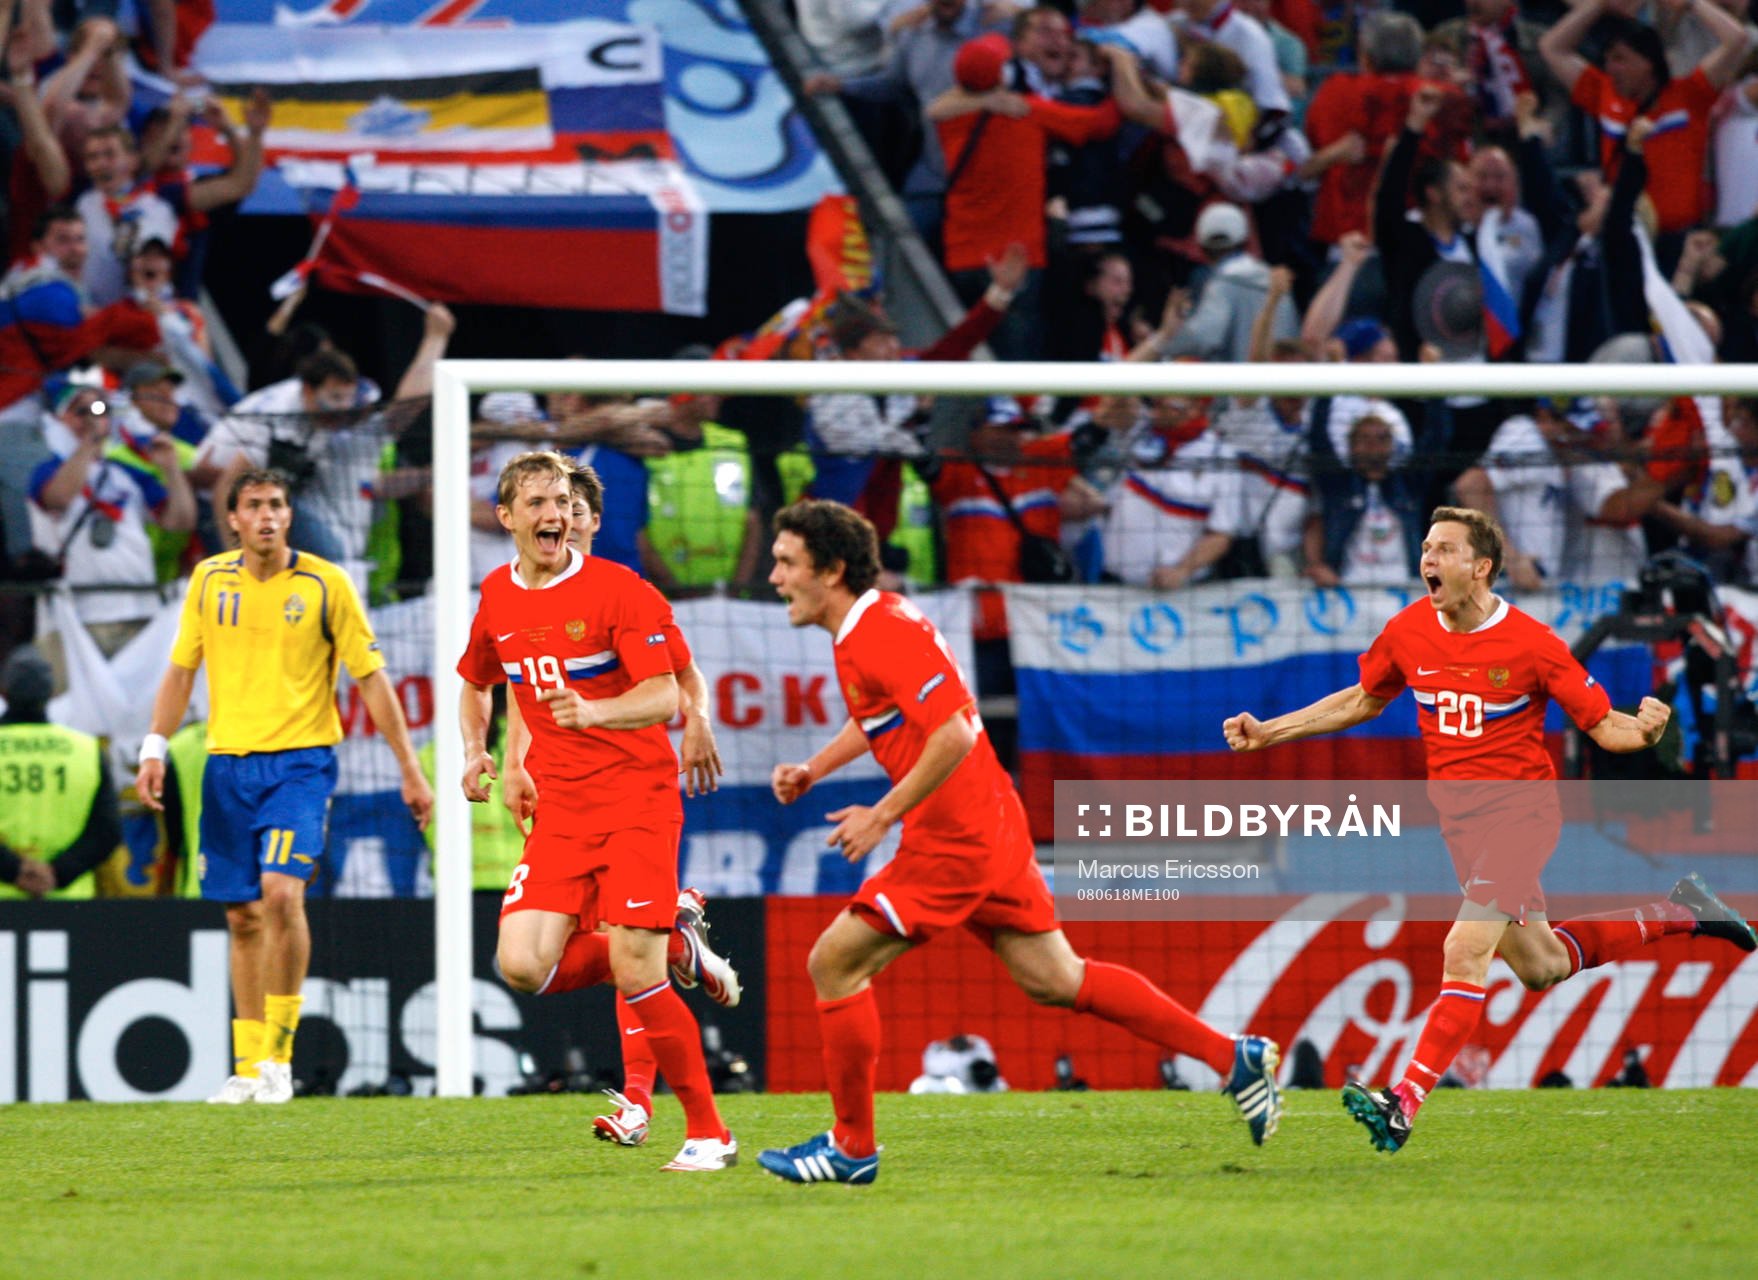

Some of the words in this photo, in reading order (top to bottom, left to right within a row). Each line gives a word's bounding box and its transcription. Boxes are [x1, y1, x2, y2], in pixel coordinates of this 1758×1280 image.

[217, 591, 241, 627] 11
[523, 655, 565, 701] 19
[1437, 690, 1483, 738] 20
[0, 763, 67, 795] 381
[264, 828, 296, 865] 11
